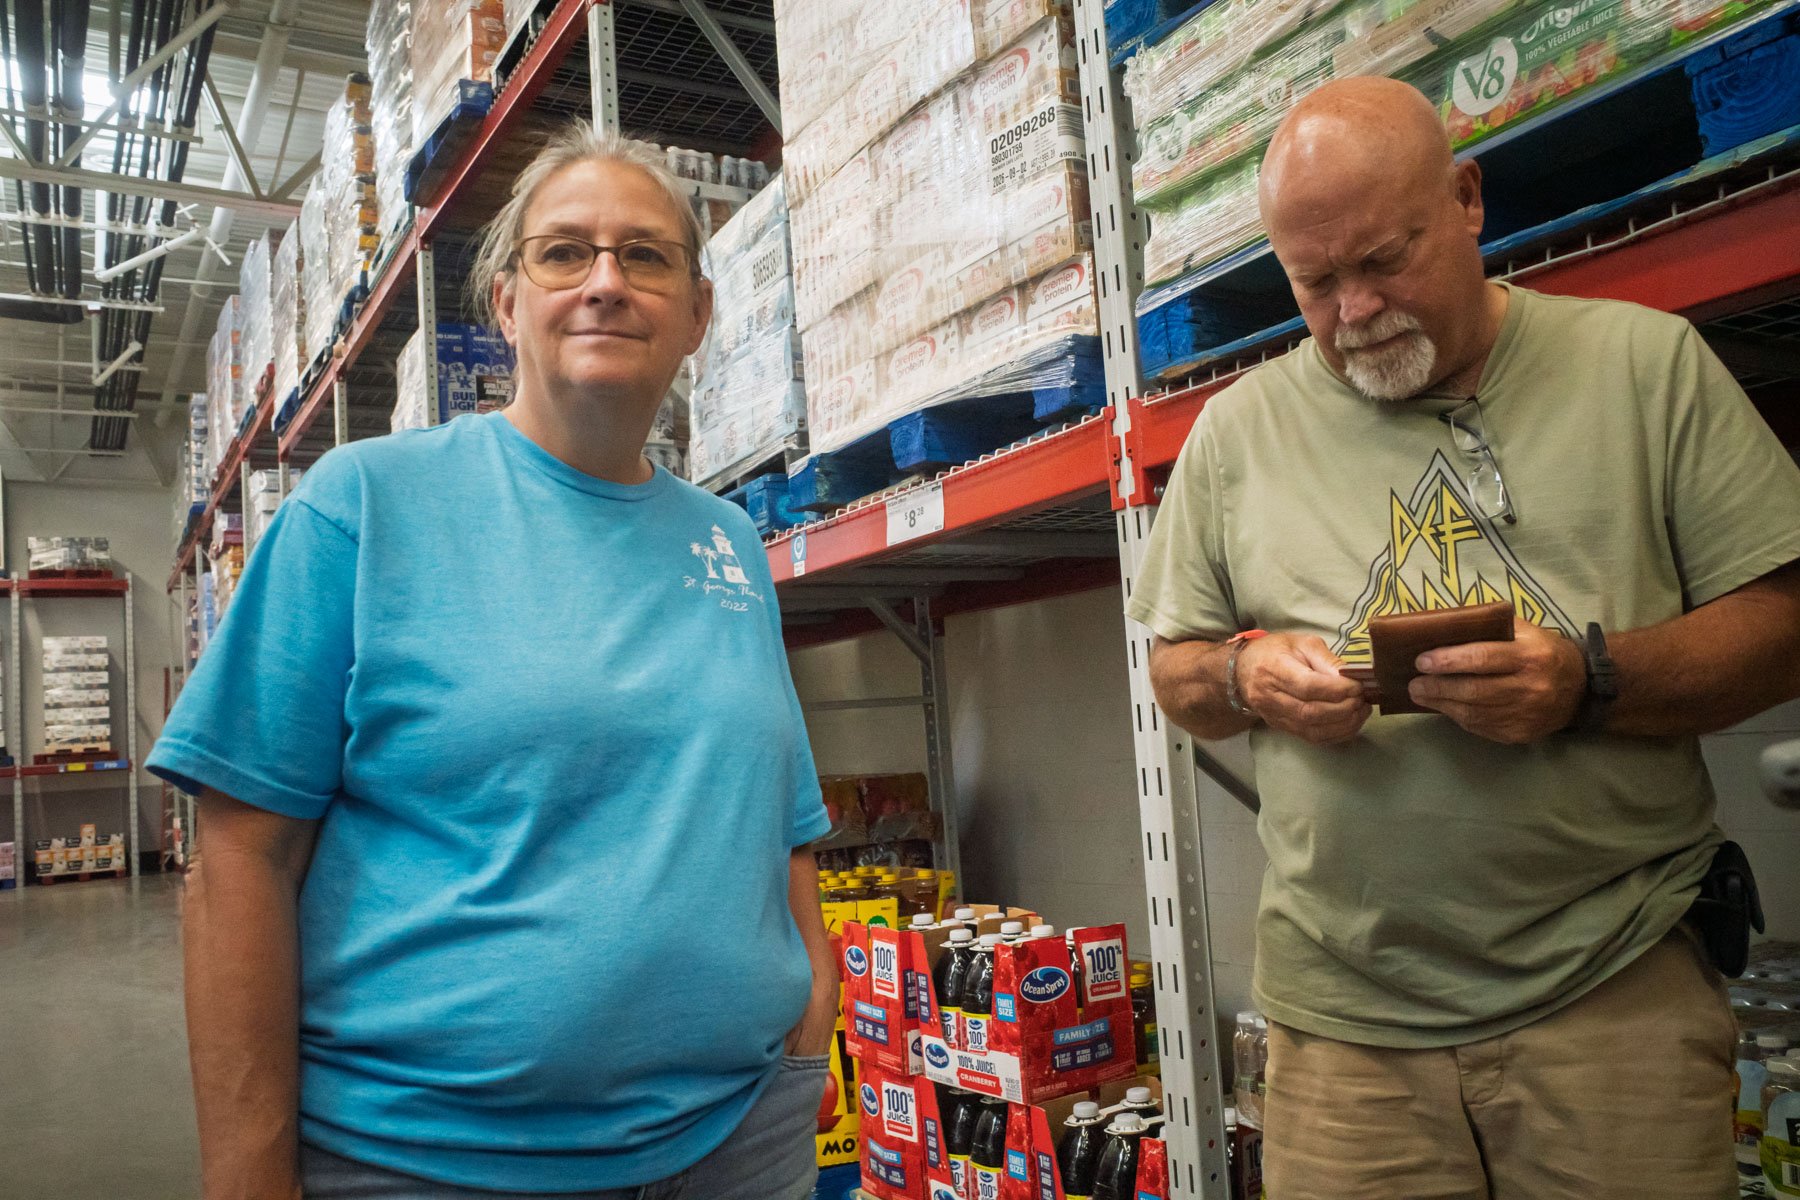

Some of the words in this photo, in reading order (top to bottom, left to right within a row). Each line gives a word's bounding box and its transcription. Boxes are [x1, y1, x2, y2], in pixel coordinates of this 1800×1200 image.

[1521, 0, 1598, 43] Origin
[1525, 44, 1546, 61] 100%
[1547, 20, 1590, 48] VEGETABLE
[1591, 7, 1614, 27] JUICE
[979, 59, 1018, 94] premier
[1461, 46, 1505, 100] V8
[982, 74, 1016, 105] protein
[991, 106, 1056, 154] 02099288
[1043, 270, 1075, 297] premier
[1045, 284, 1073, 304] protein
[978, 303, 1008, 327] premier
[980, 316, 1005, 334] protein
[895, 345, 926, 369] premier
[897, 359, 924, 380] protein
[453, 391, 476, 401] BUD
[450, 401, 476, 411] LIGH
[721, 599, 748, 612] 2022
[874, 946, 896, 972] 100%
[1086, 945, 1122, 974] 100%
[876, 969, 893, 982] JUICE
[1091, 971, 1119, 984] JUICE
[1023, 981, 1046, 995] Ocean
[1045, 976, 1066, 994] Spray
[1093, 984, 1119, 993] CRANBERRY
[998, 998, 1013, 1008] FAMILY
[998, 1006, 1014, 1017] SIZE
[969, 1031, 987, 1045] 100%
[1059, 1028, 1091, 1042] FAMILY
[958, 1055, 974, 1070] 100%
[960, 1073, 997, 1087] CRANBERRY
[885, 1088, 914, 1115] 100%
[887, 1111, 911, 1125] JUICE
[822, 1138, 860, 1156] MO
[883, 1151, 898, 1161] SIZE
[1009, 1163, 1025, 1175] SIZE
